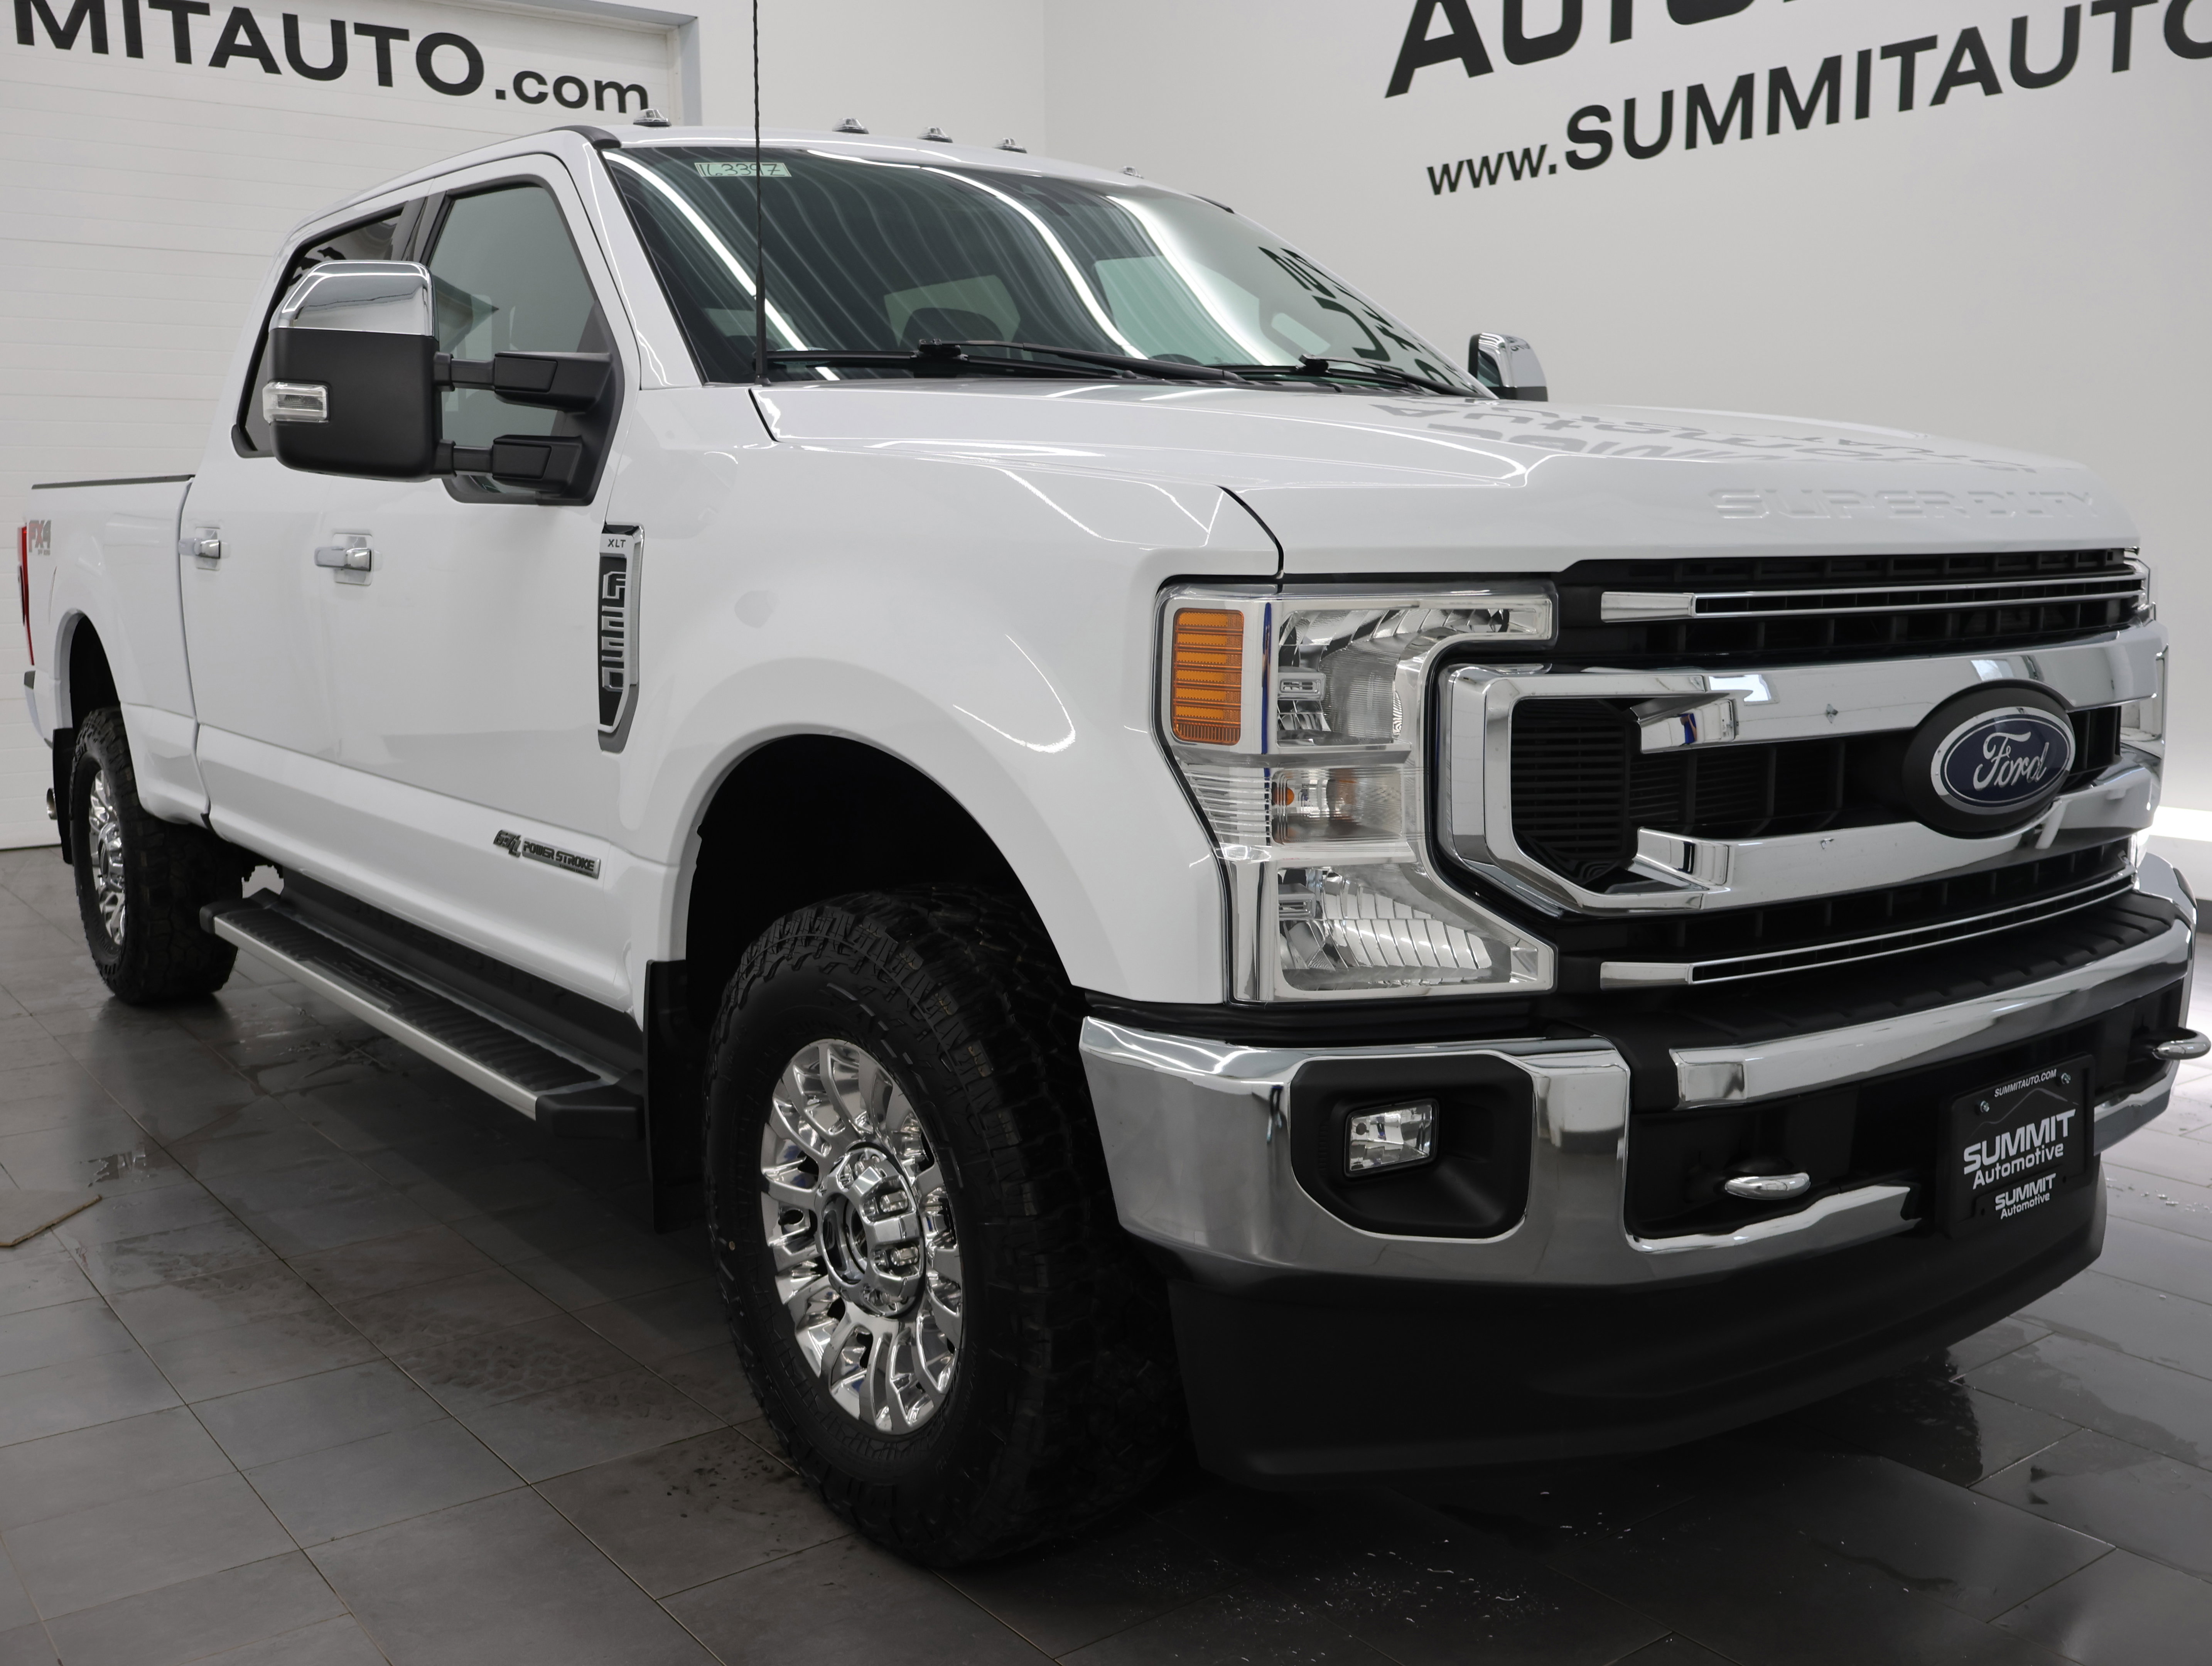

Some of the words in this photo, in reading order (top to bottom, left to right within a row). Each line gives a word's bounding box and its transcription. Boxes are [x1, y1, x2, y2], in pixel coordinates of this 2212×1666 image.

[1708, 488, 1971, 519] SUPER
[1967, 491, 2098, 518] DUTY
[29, 520, 52, 552] FX4
[608, 539, 626, 548] XLT
[1973, 732, 2050, 791] Ford
[523, 840, 555, 860] POWER
[555, 850, 595, 872] STROKE
[1994, 1069, 2057, 1098] SUMMITAUTO.COM
[1964, 1109, 2076, 1175] SUMMIT
[1972, 1143, 2064, 1190] Automotive
[1995, 1173, 2057, 1211] SUMMIT
[2000, 1192, 2050, 1220] Automotive
